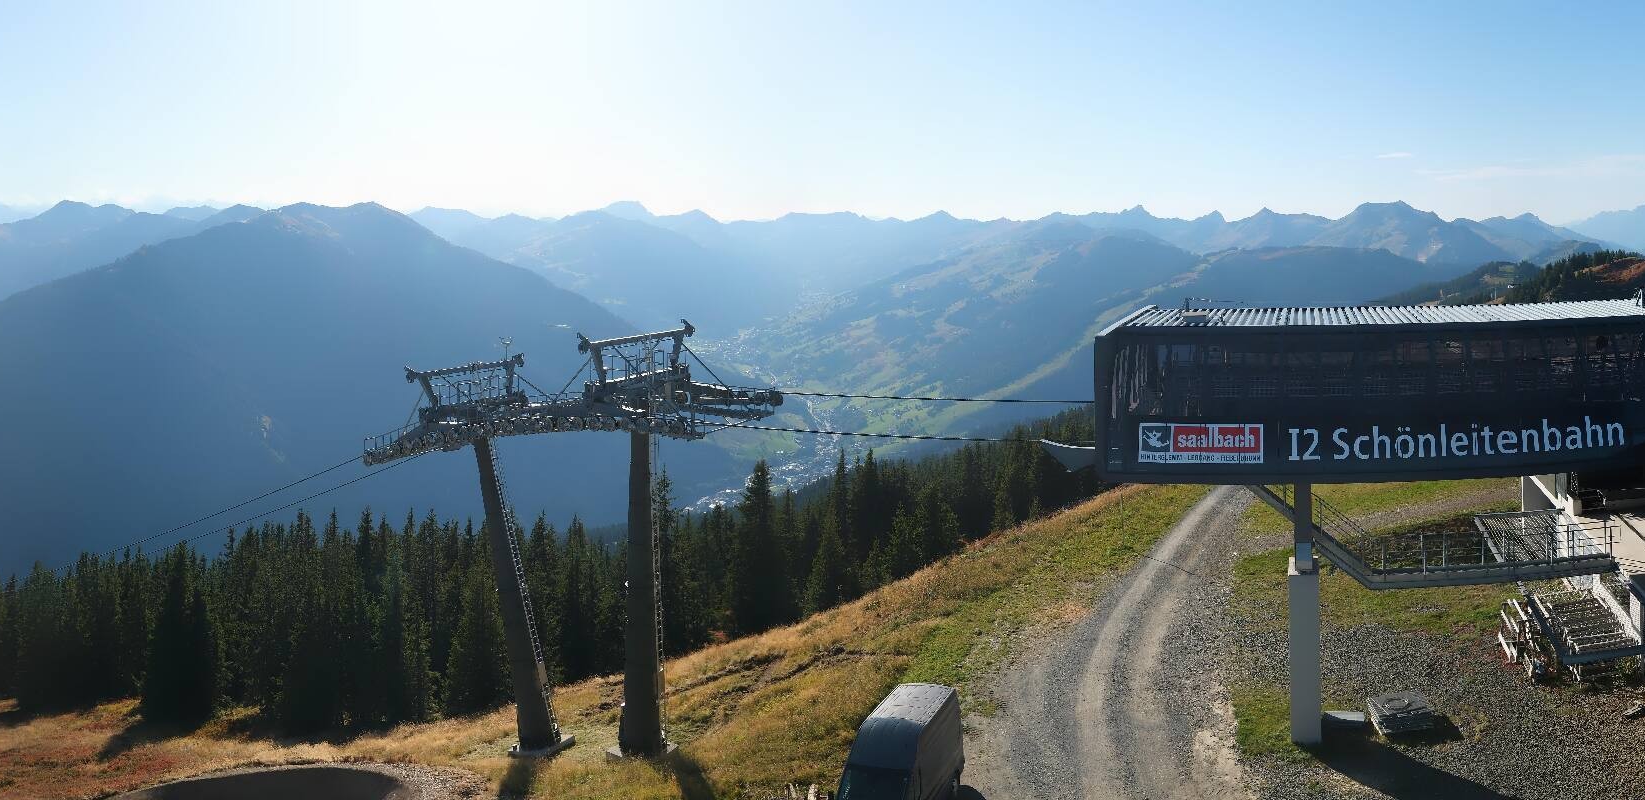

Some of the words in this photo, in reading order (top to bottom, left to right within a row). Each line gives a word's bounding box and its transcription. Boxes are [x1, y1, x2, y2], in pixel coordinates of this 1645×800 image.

[1177, 426, 1255, 448] saalbach
[1288, 428, 1321, 461] I2
[1332, 415, 1625, 460] Schönleitenbahn
